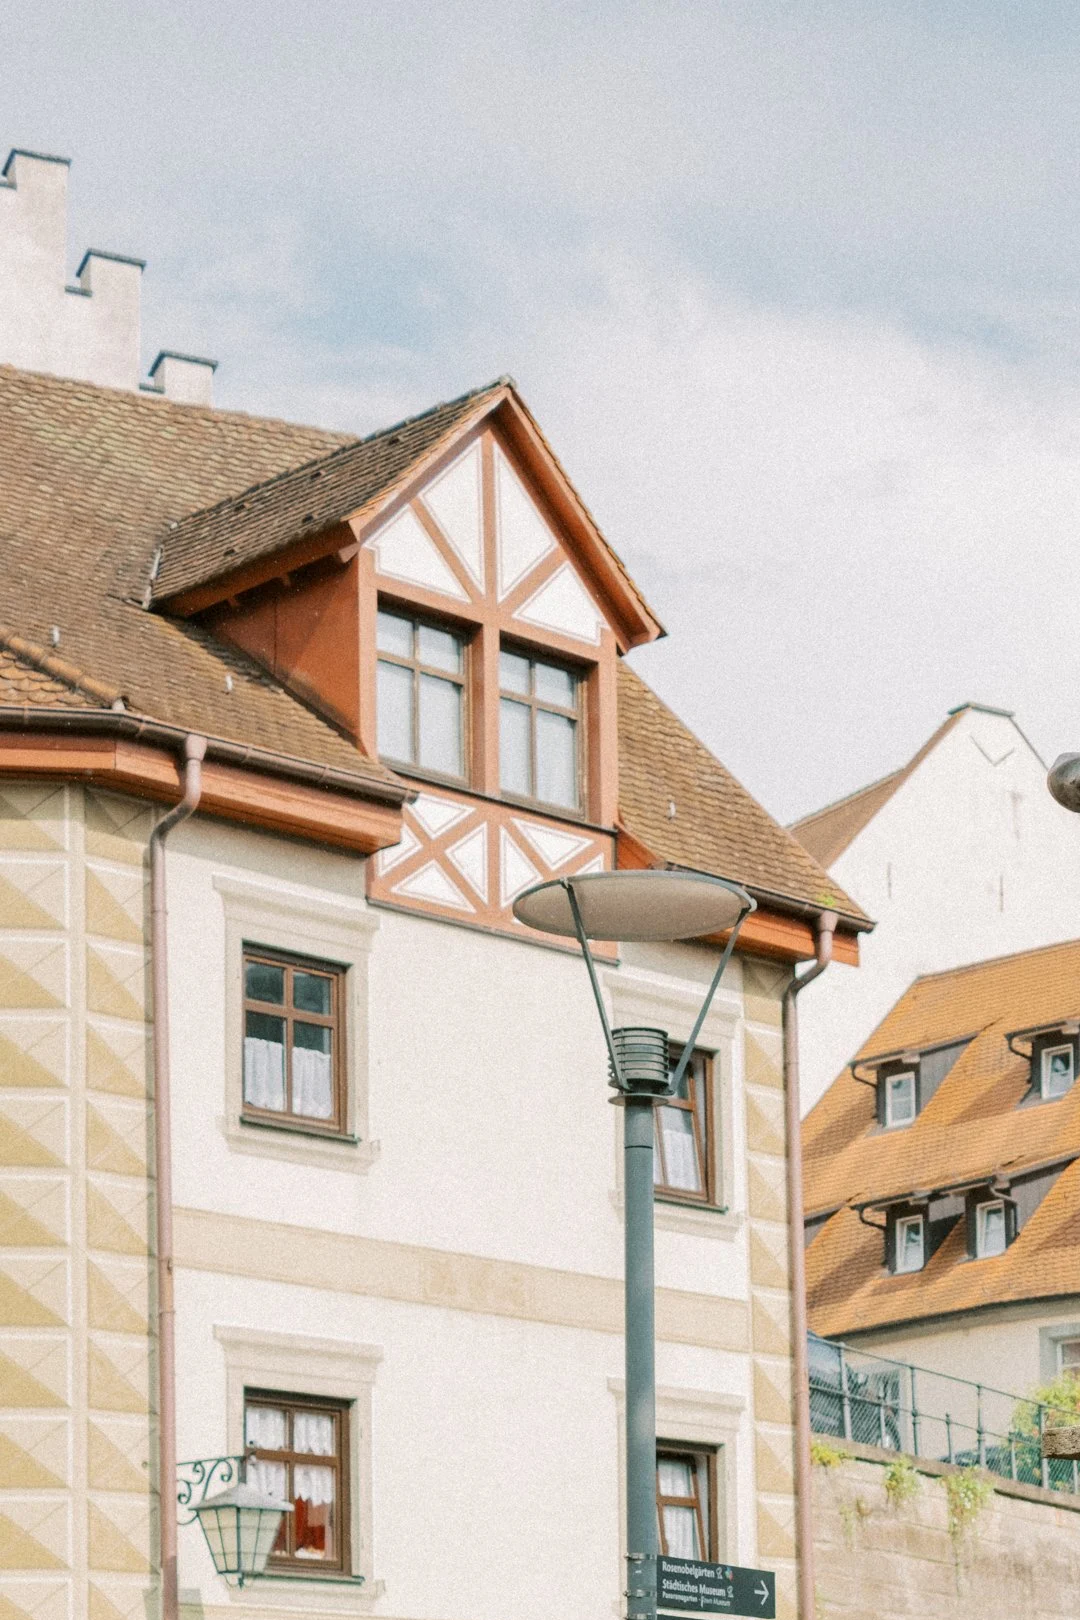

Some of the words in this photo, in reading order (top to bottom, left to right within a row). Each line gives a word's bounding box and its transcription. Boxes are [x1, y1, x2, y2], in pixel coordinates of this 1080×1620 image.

[662, 1561, 714, 1579] Rosenobelgärten
[662, 1579, 698, 1593] Städtisches
[700, 1584, 726, 1597] Museum
